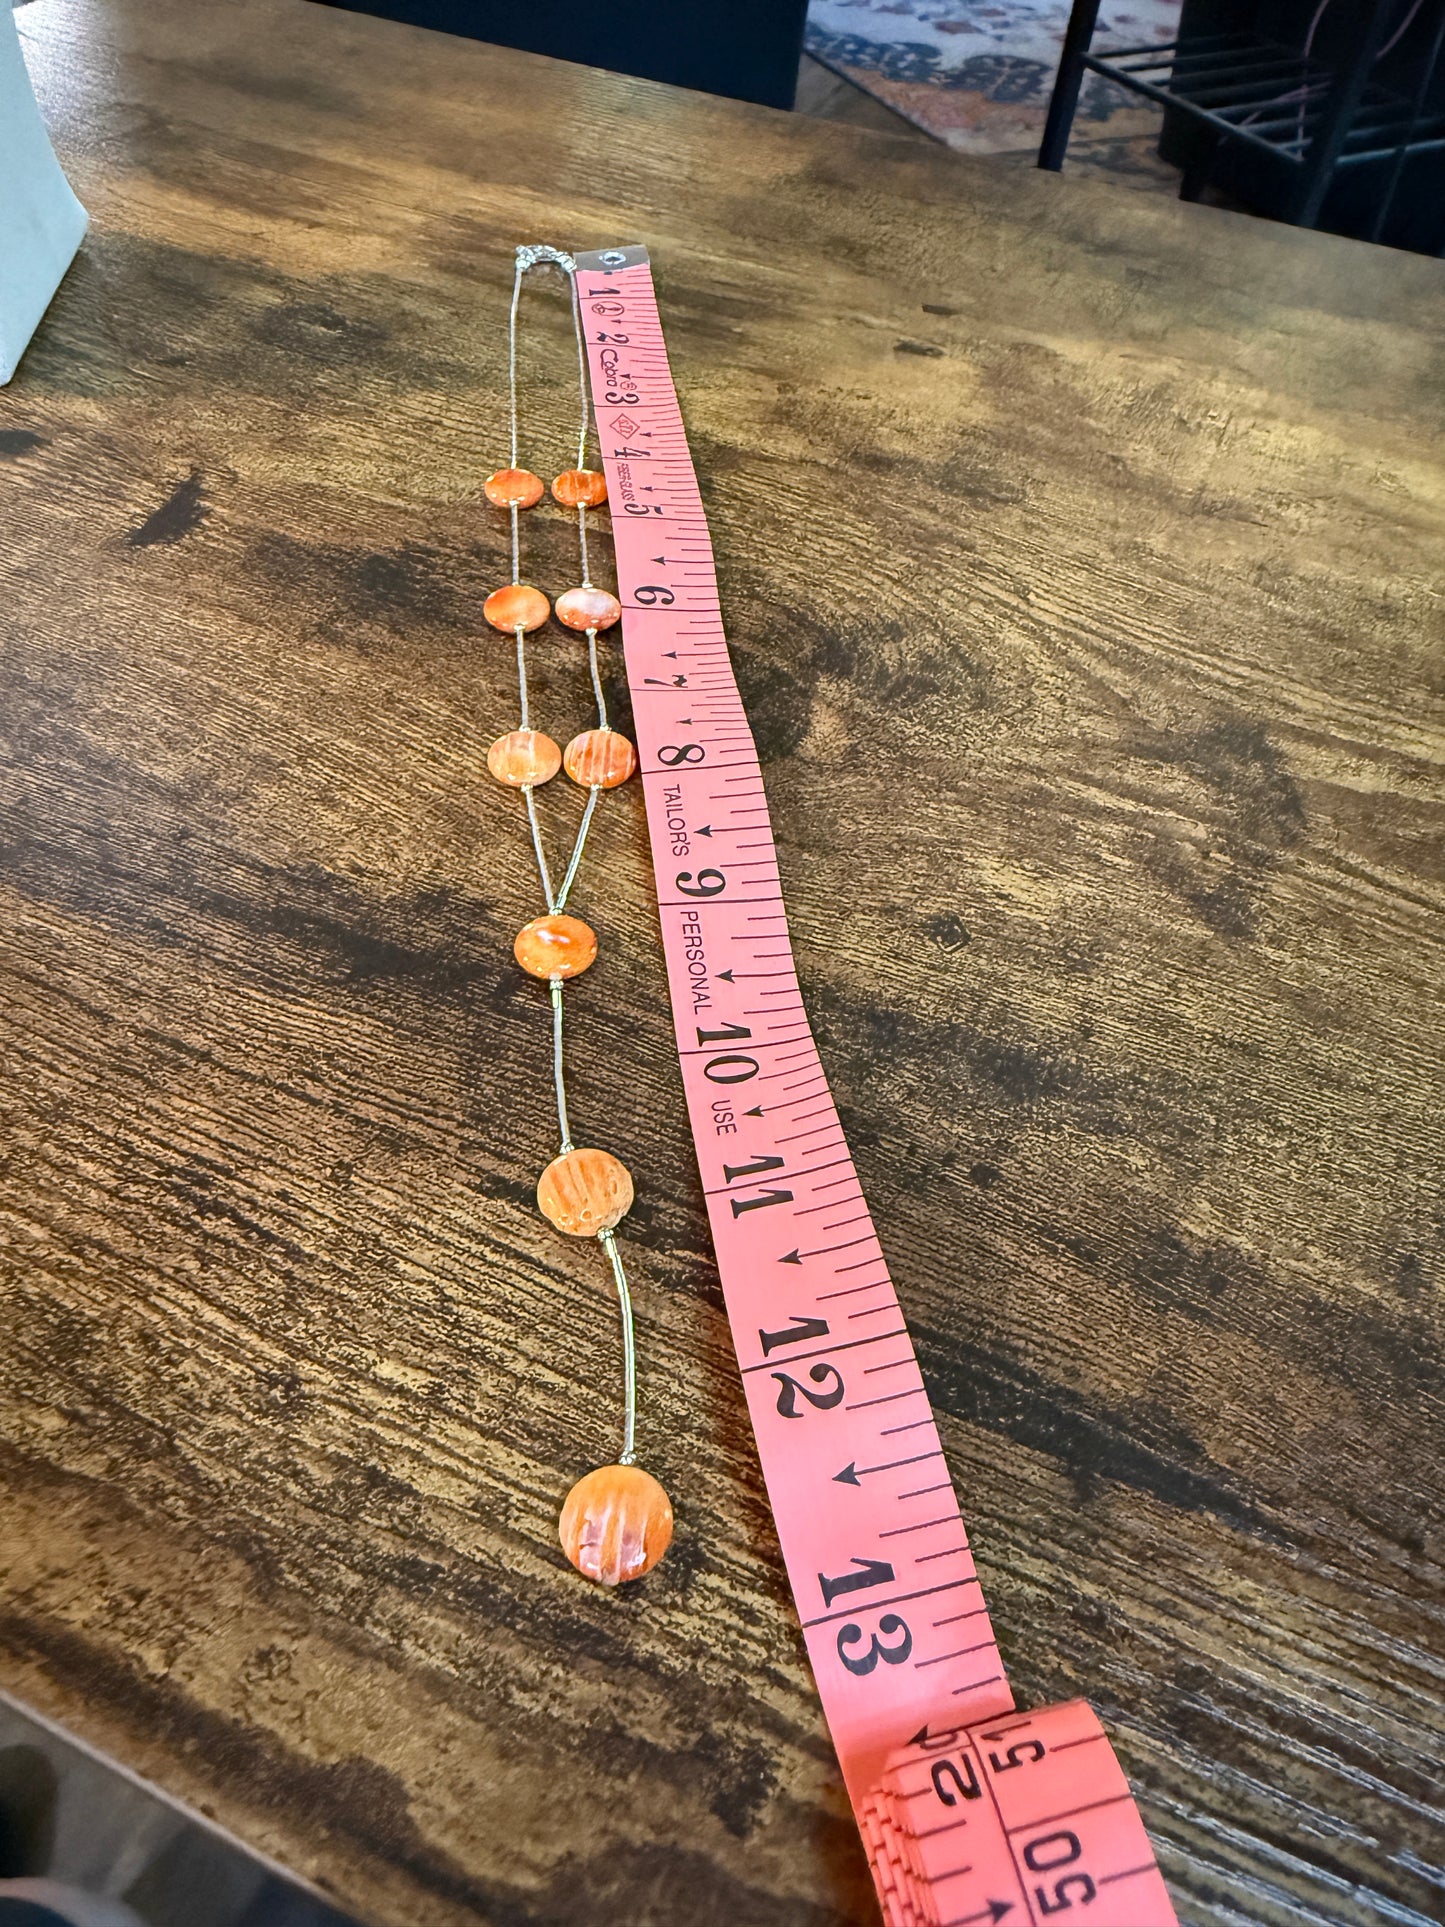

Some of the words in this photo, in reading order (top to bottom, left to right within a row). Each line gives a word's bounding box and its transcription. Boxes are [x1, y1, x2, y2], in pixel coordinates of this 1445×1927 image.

[588, 287, 621, 297] 1
[596, 331, 630, 344] 2
[600, 348, 619, 387] Cobra
[604, 391, 640, 405] 3
[614, 446, 651, 458] 4
[624, 503, 664, 516] 5
[634, 585, 675, 605] 6
[643, 674, 689, 689] 7
[657, 743, 706, 766] 8
[663, 783, 690, 857] TAILOR'S
[675, 868, 726, 898] 9
[680, 910, 712, 1015] PERSONAL
[696, 1021, 760, 1085] 10
[711, 1099, 738, 1136] USE
[723, 1155, 794, 1220] 11
[758, 1316, 845, 1419] 12
[817, 1556, 913, 1677] 13
[1023, 1830, 1097, 1917] 50
